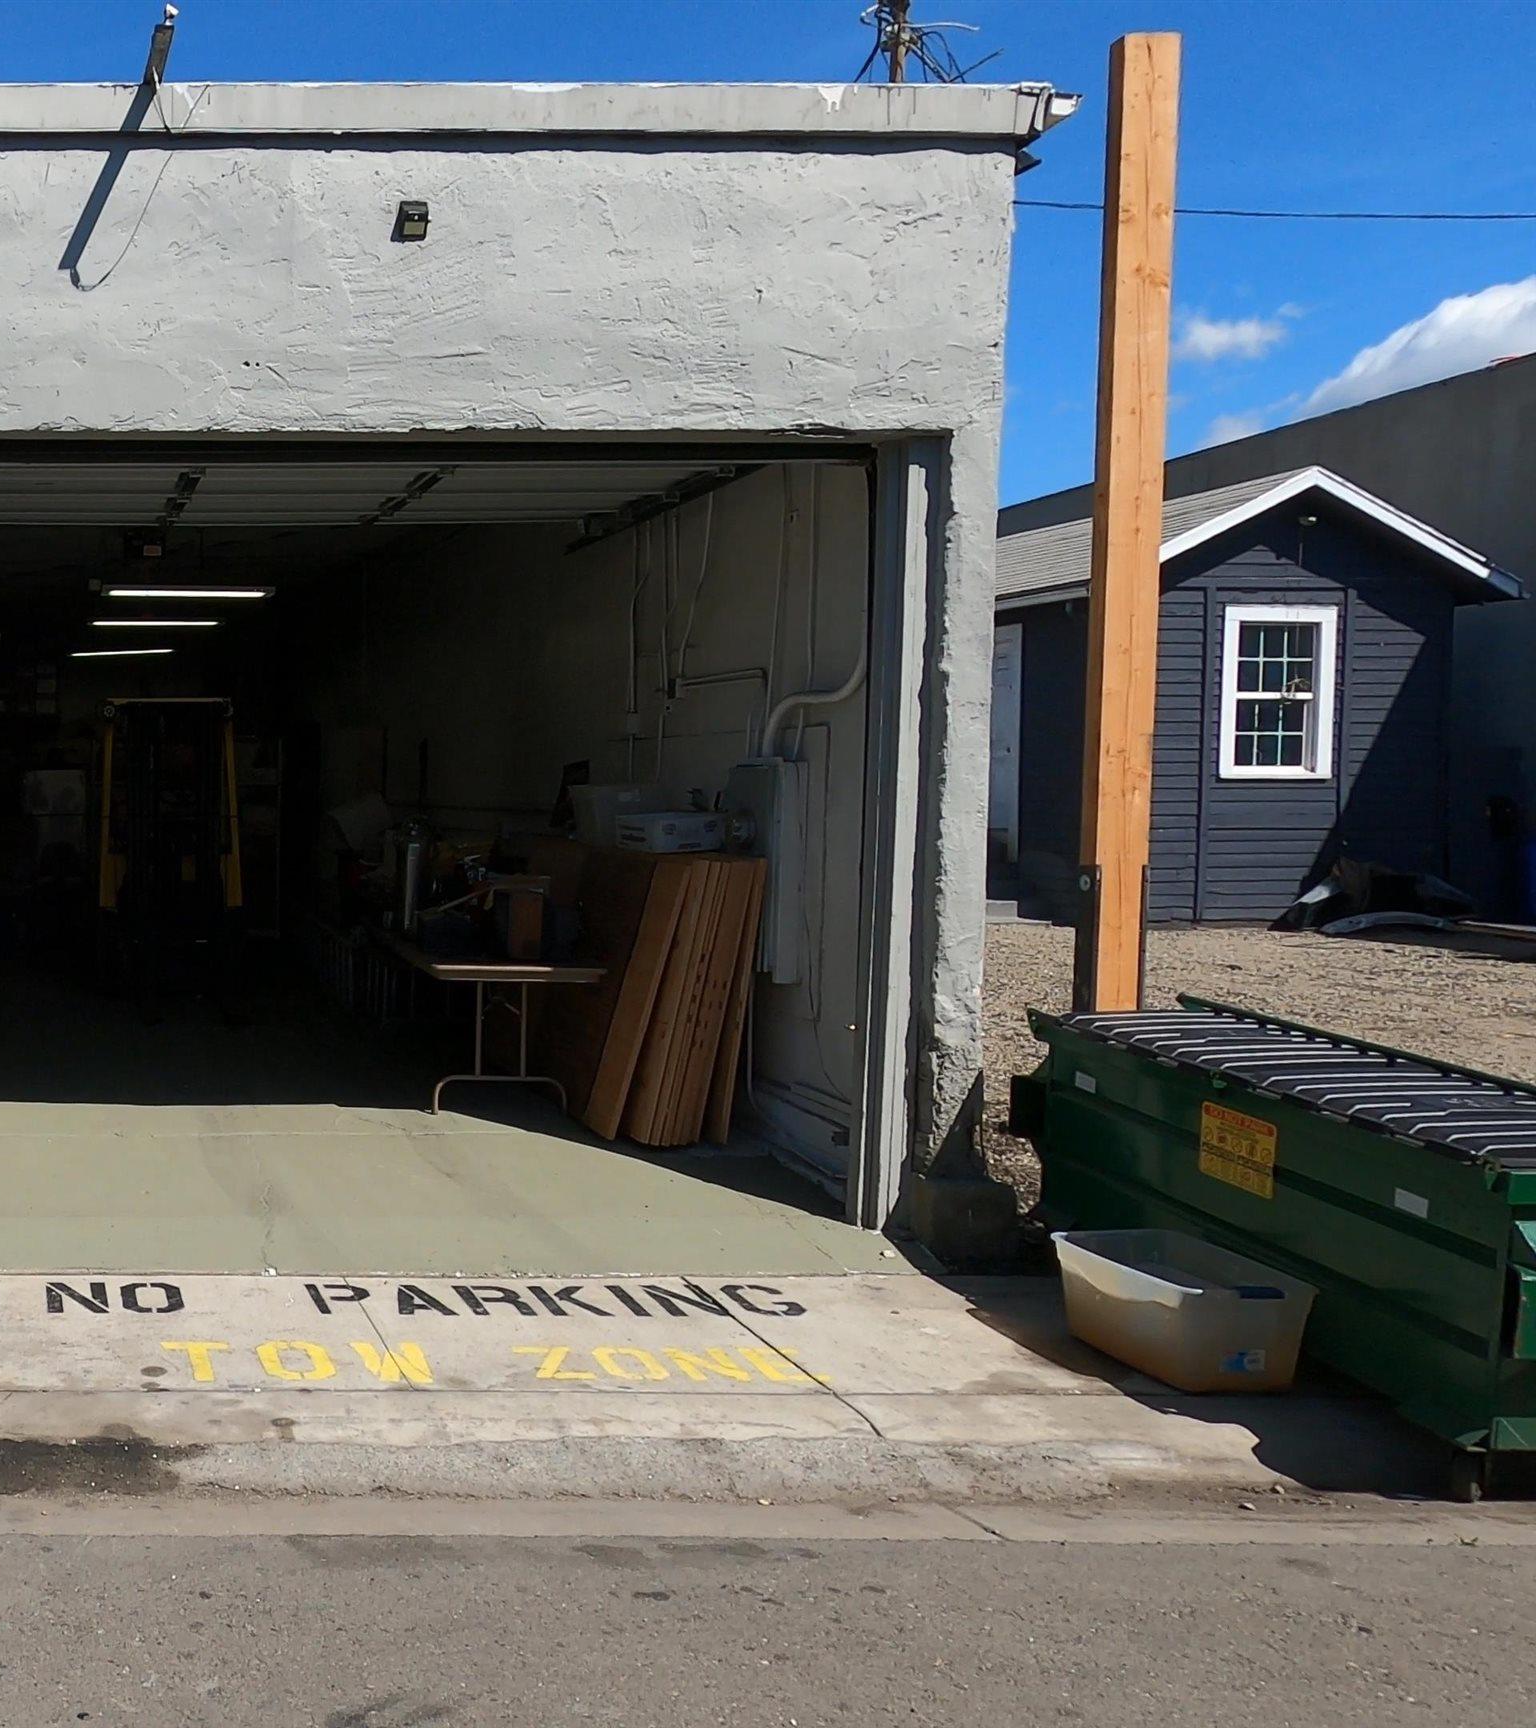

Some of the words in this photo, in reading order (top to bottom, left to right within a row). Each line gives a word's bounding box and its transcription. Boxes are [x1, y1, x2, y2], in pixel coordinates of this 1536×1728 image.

[45, 1282, 185, 1314] NO
[304, 1283, 807, 1317] PARKING
[160, 1340, 435, 1383] TOW
[512, 1344, 832, 1383] ZONE
